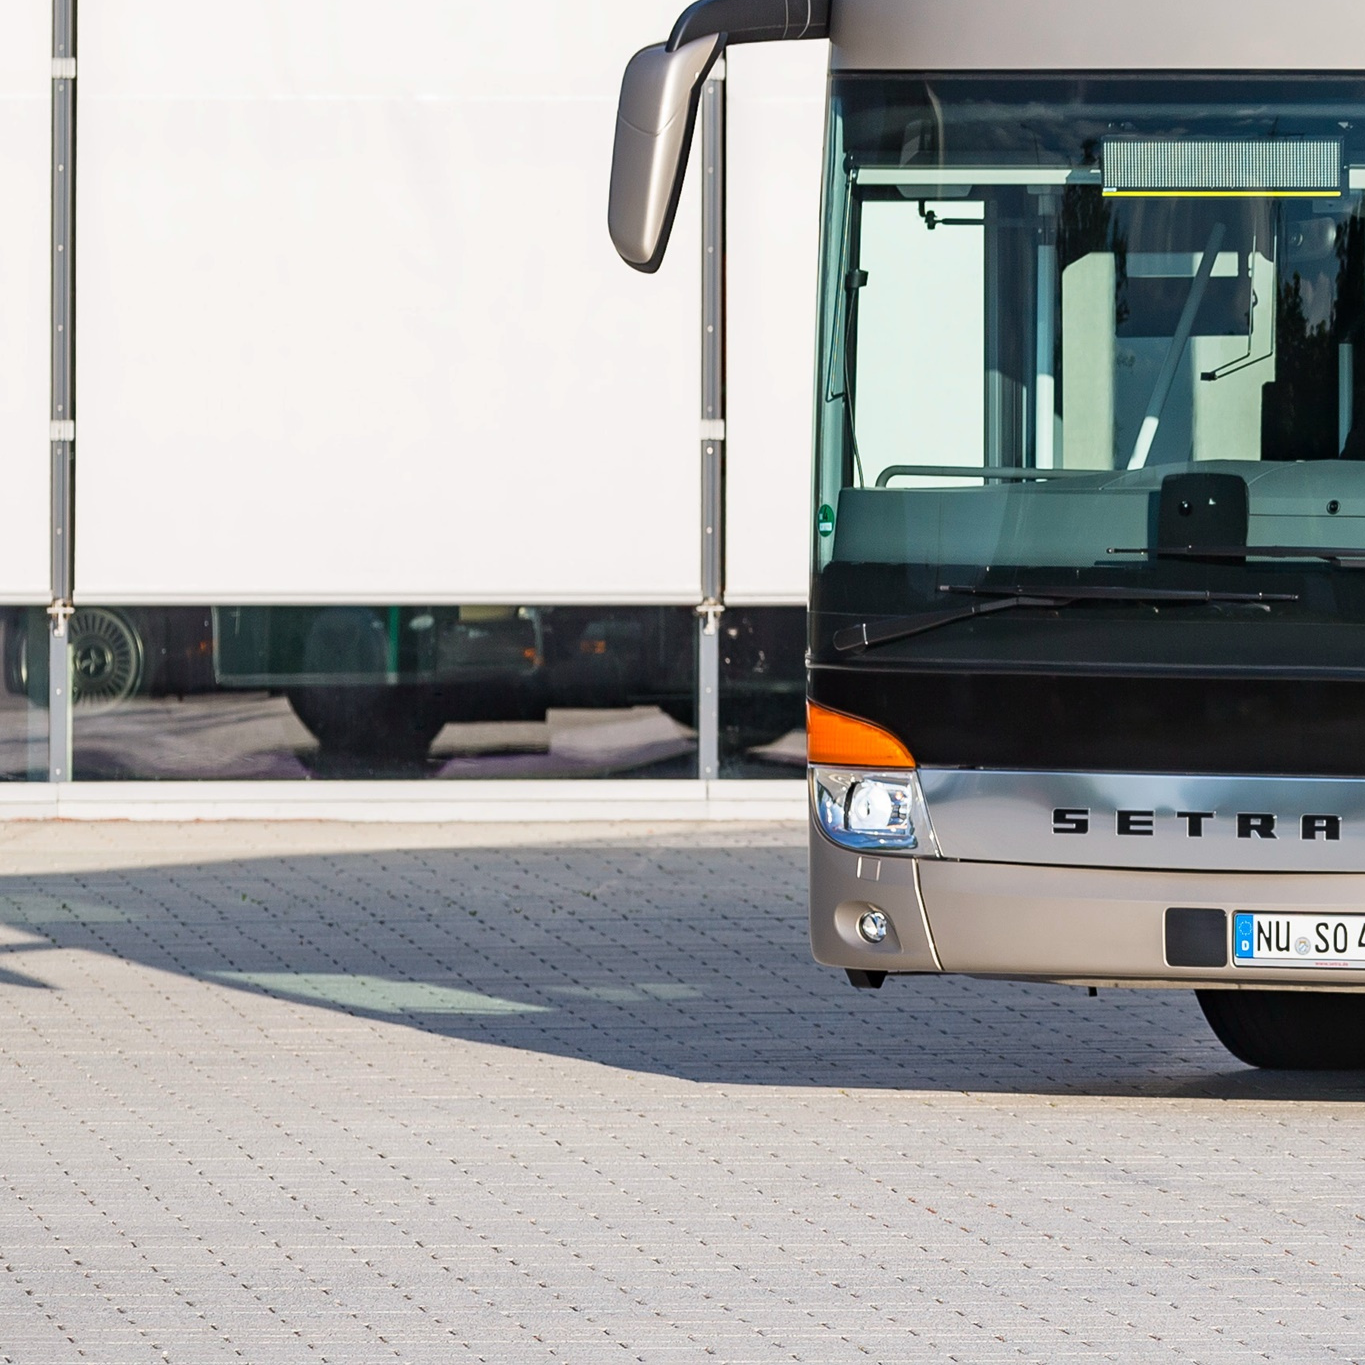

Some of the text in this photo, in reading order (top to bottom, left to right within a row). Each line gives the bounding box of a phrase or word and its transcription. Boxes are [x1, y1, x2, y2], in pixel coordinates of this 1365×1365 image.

[1051, 807, 1342, 841] SETRA
[1241, 940, 1250, 951] D
[1257, 920, 1291, 952] NU
[1315, 922, 1348, 954] SO
